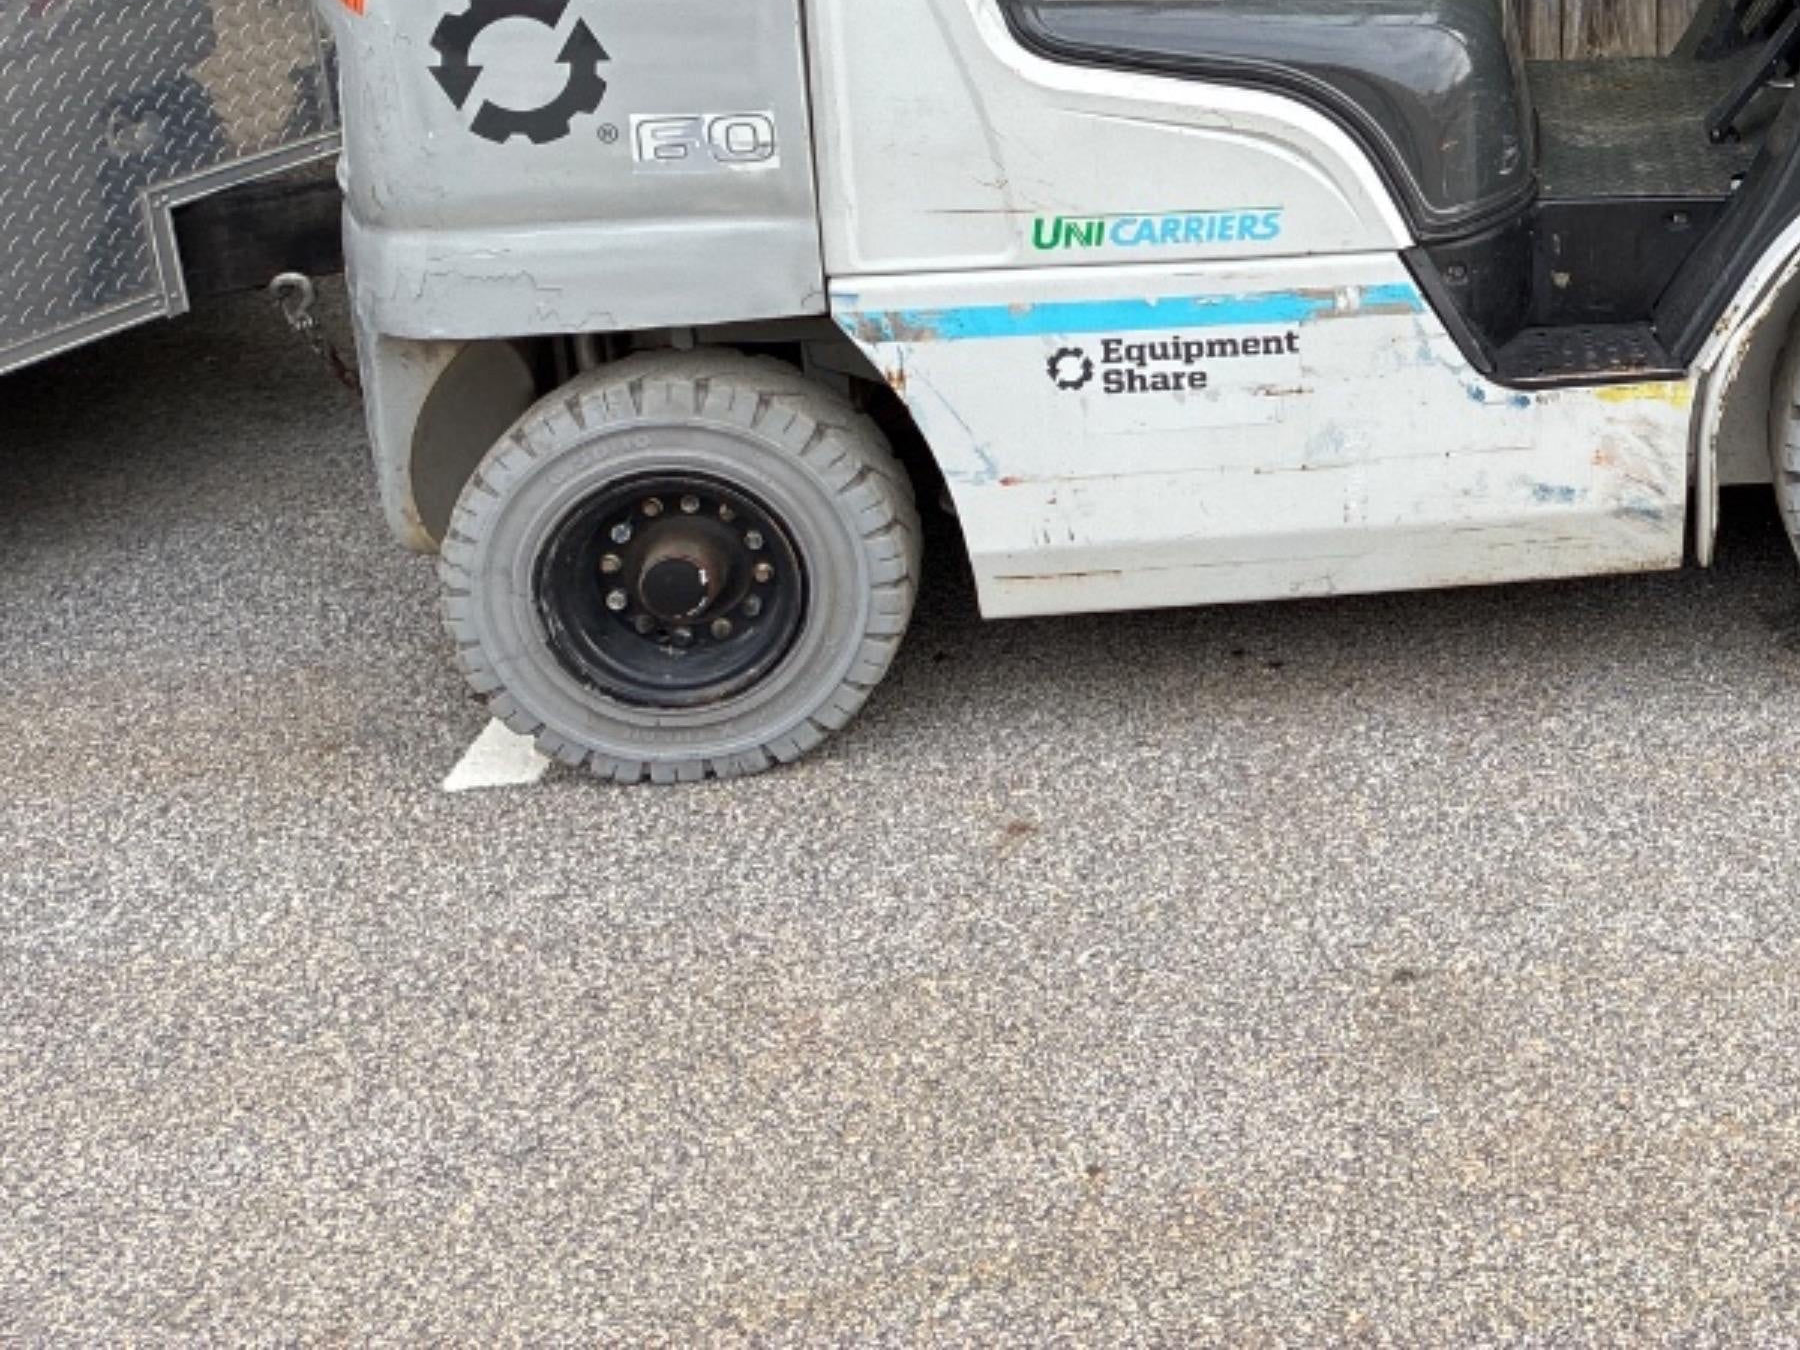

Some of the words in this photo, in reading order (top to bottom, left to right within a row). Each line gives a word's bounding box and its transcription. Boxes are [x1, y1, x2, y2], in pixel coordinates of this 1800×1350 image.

[1031, 212, 1281, 250] UNICARRIERS
[1101, 331, 1300, 367] Equipment
[1103, 367, 1208, 394] Share
